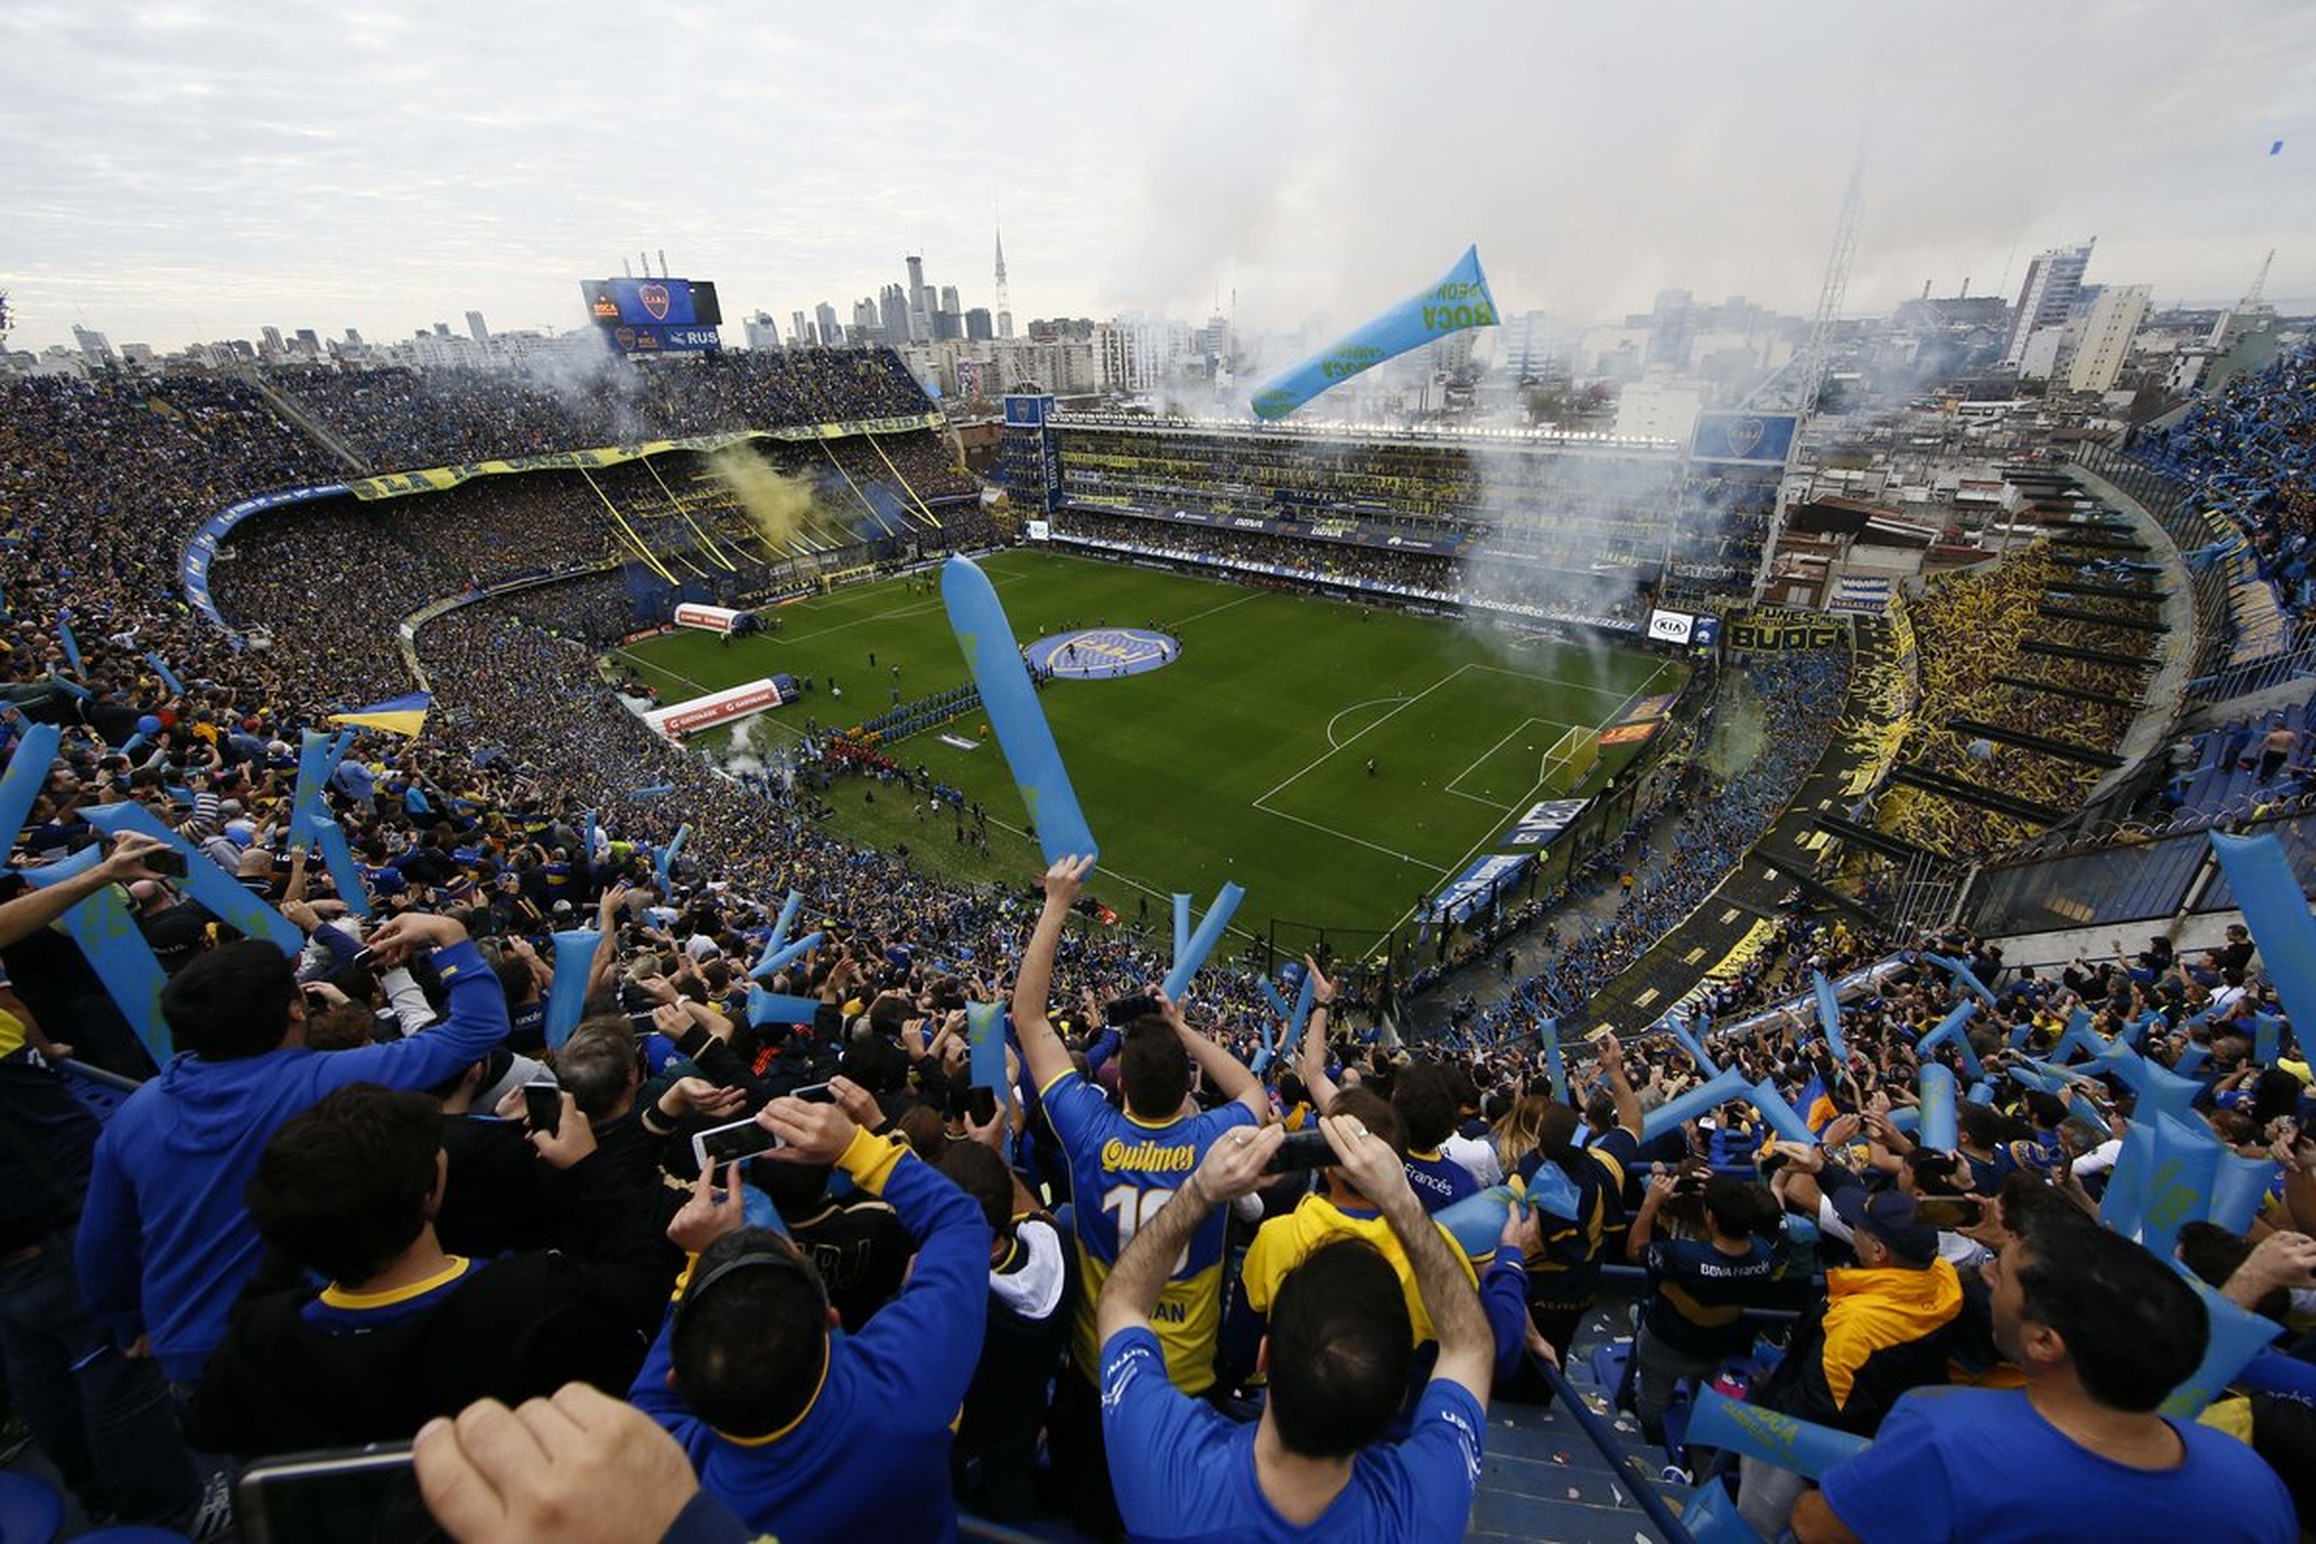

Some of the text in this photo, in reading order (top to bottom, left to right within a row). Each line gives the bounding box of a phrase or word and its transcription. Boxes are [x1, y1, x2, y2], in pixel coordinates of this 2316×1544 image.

[1422, 301, 1494, 331] BOCA
[1218, 557, 1275, 574] LA NUEVA
[1297, 569, 1315, 580] LA
[1387, 584, 1460, 603] LA NUEVA
[1660, 621, 1682, 632] KIA
[1101, 1137, 1196, 1173] Quilmes
[1404, 1162, 1453, 1196] Francés
[1700, 1263, 1732, 1277] BBVA
[1149, 1302, 1185, 1323] AN
